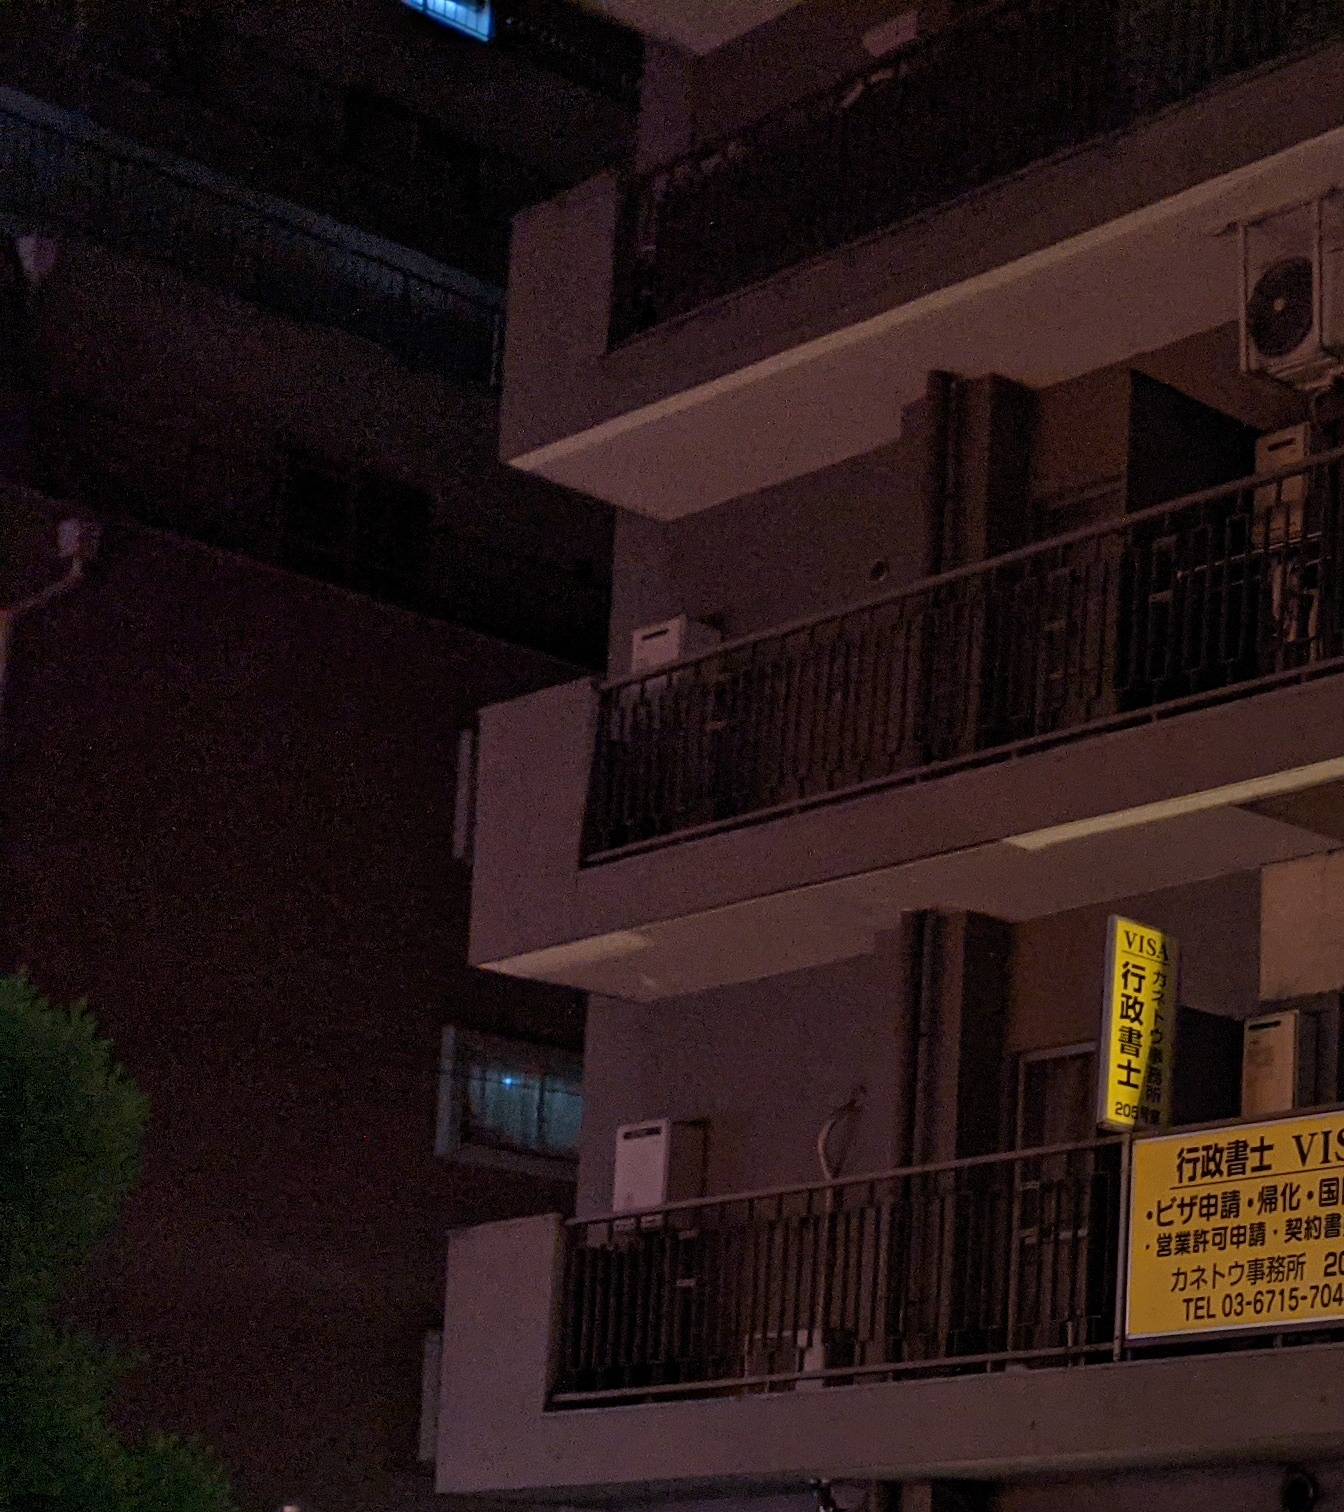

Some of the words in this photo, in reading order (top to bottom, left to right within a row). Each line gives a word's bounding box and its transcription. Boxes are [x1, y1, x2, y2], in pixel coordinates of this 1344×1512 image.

[1124, 930, 1168, 961] VISA
[1117, 961, 1146, 1089] 行政書士
[1177, 1136, 1273, 1183] 行政書士
[1171, 1254, 1307, 1293] カネトウ事務所
[1183, 1297, 1216, 1321] TEL
